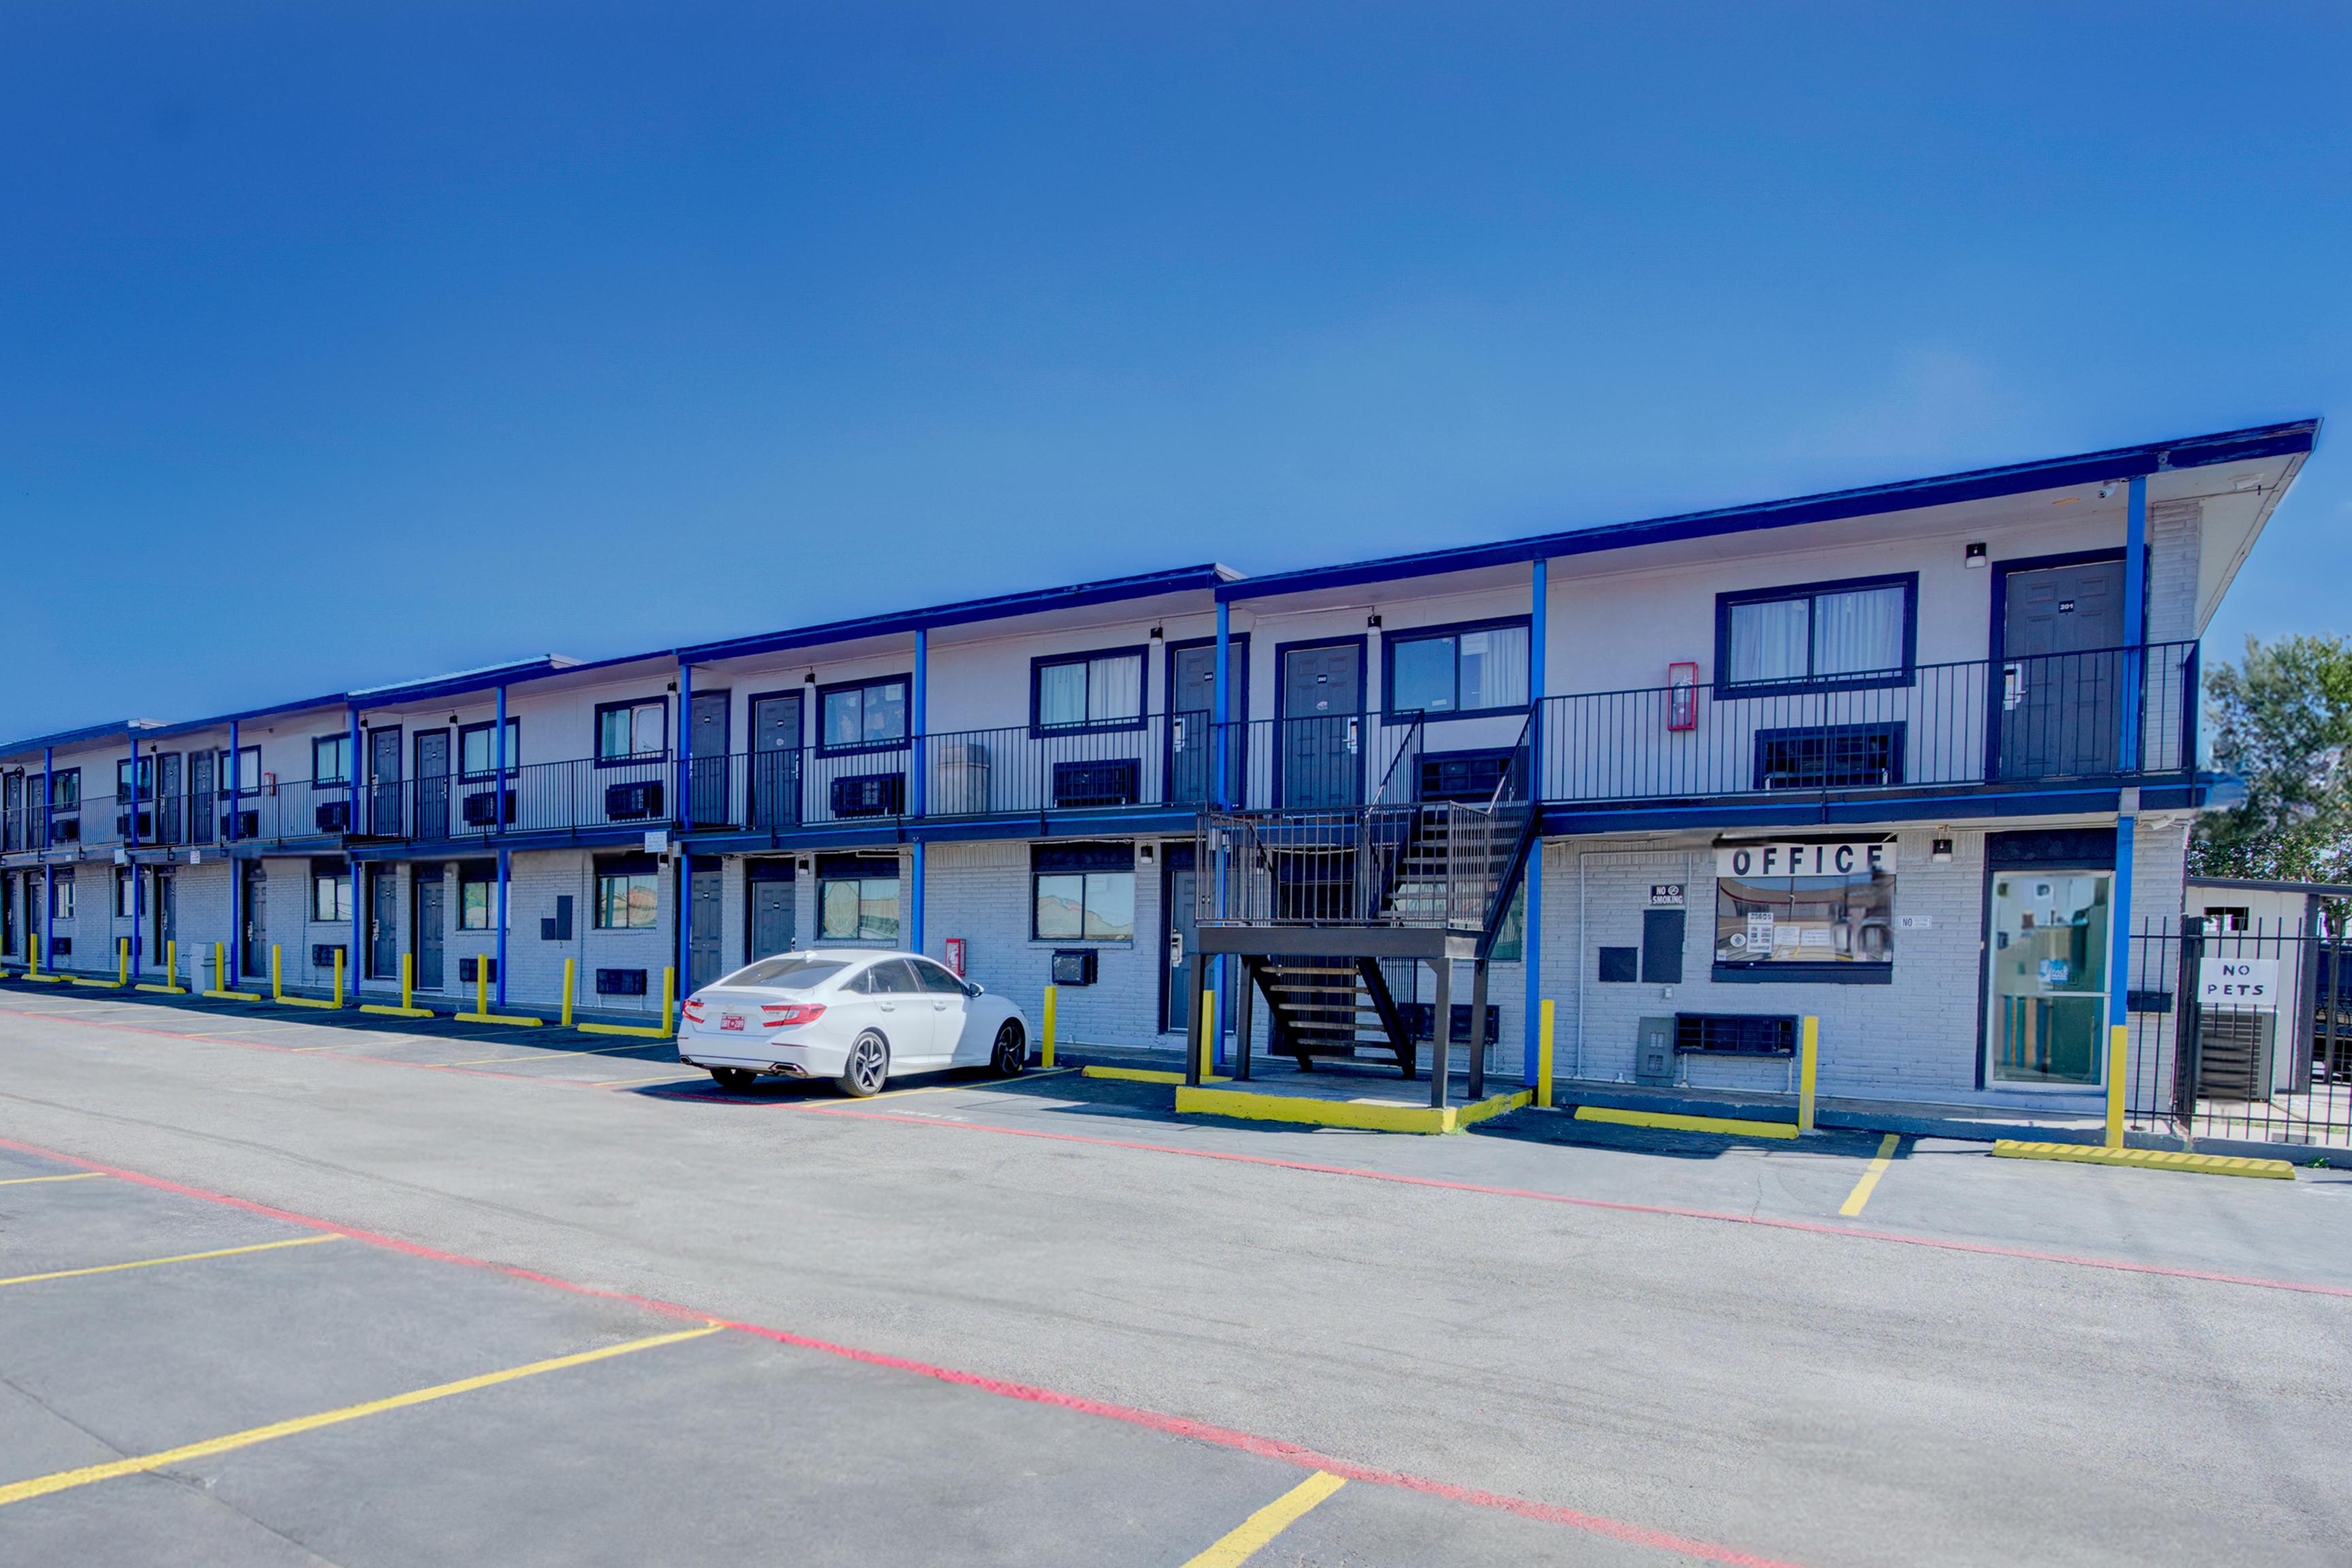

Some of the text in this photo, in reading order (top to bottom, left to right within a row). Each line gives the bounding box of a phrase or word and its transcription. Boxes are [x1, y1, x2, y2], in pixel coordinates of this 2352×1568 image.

[1656, 886, 1666, 895] NO
[1652, 895, 1683, 904] SMOKING
[1903, 918, 1912, 926] NO
[2223, 965, 2250, 976] NO
[2207, 984, 2264, 996] PETS
